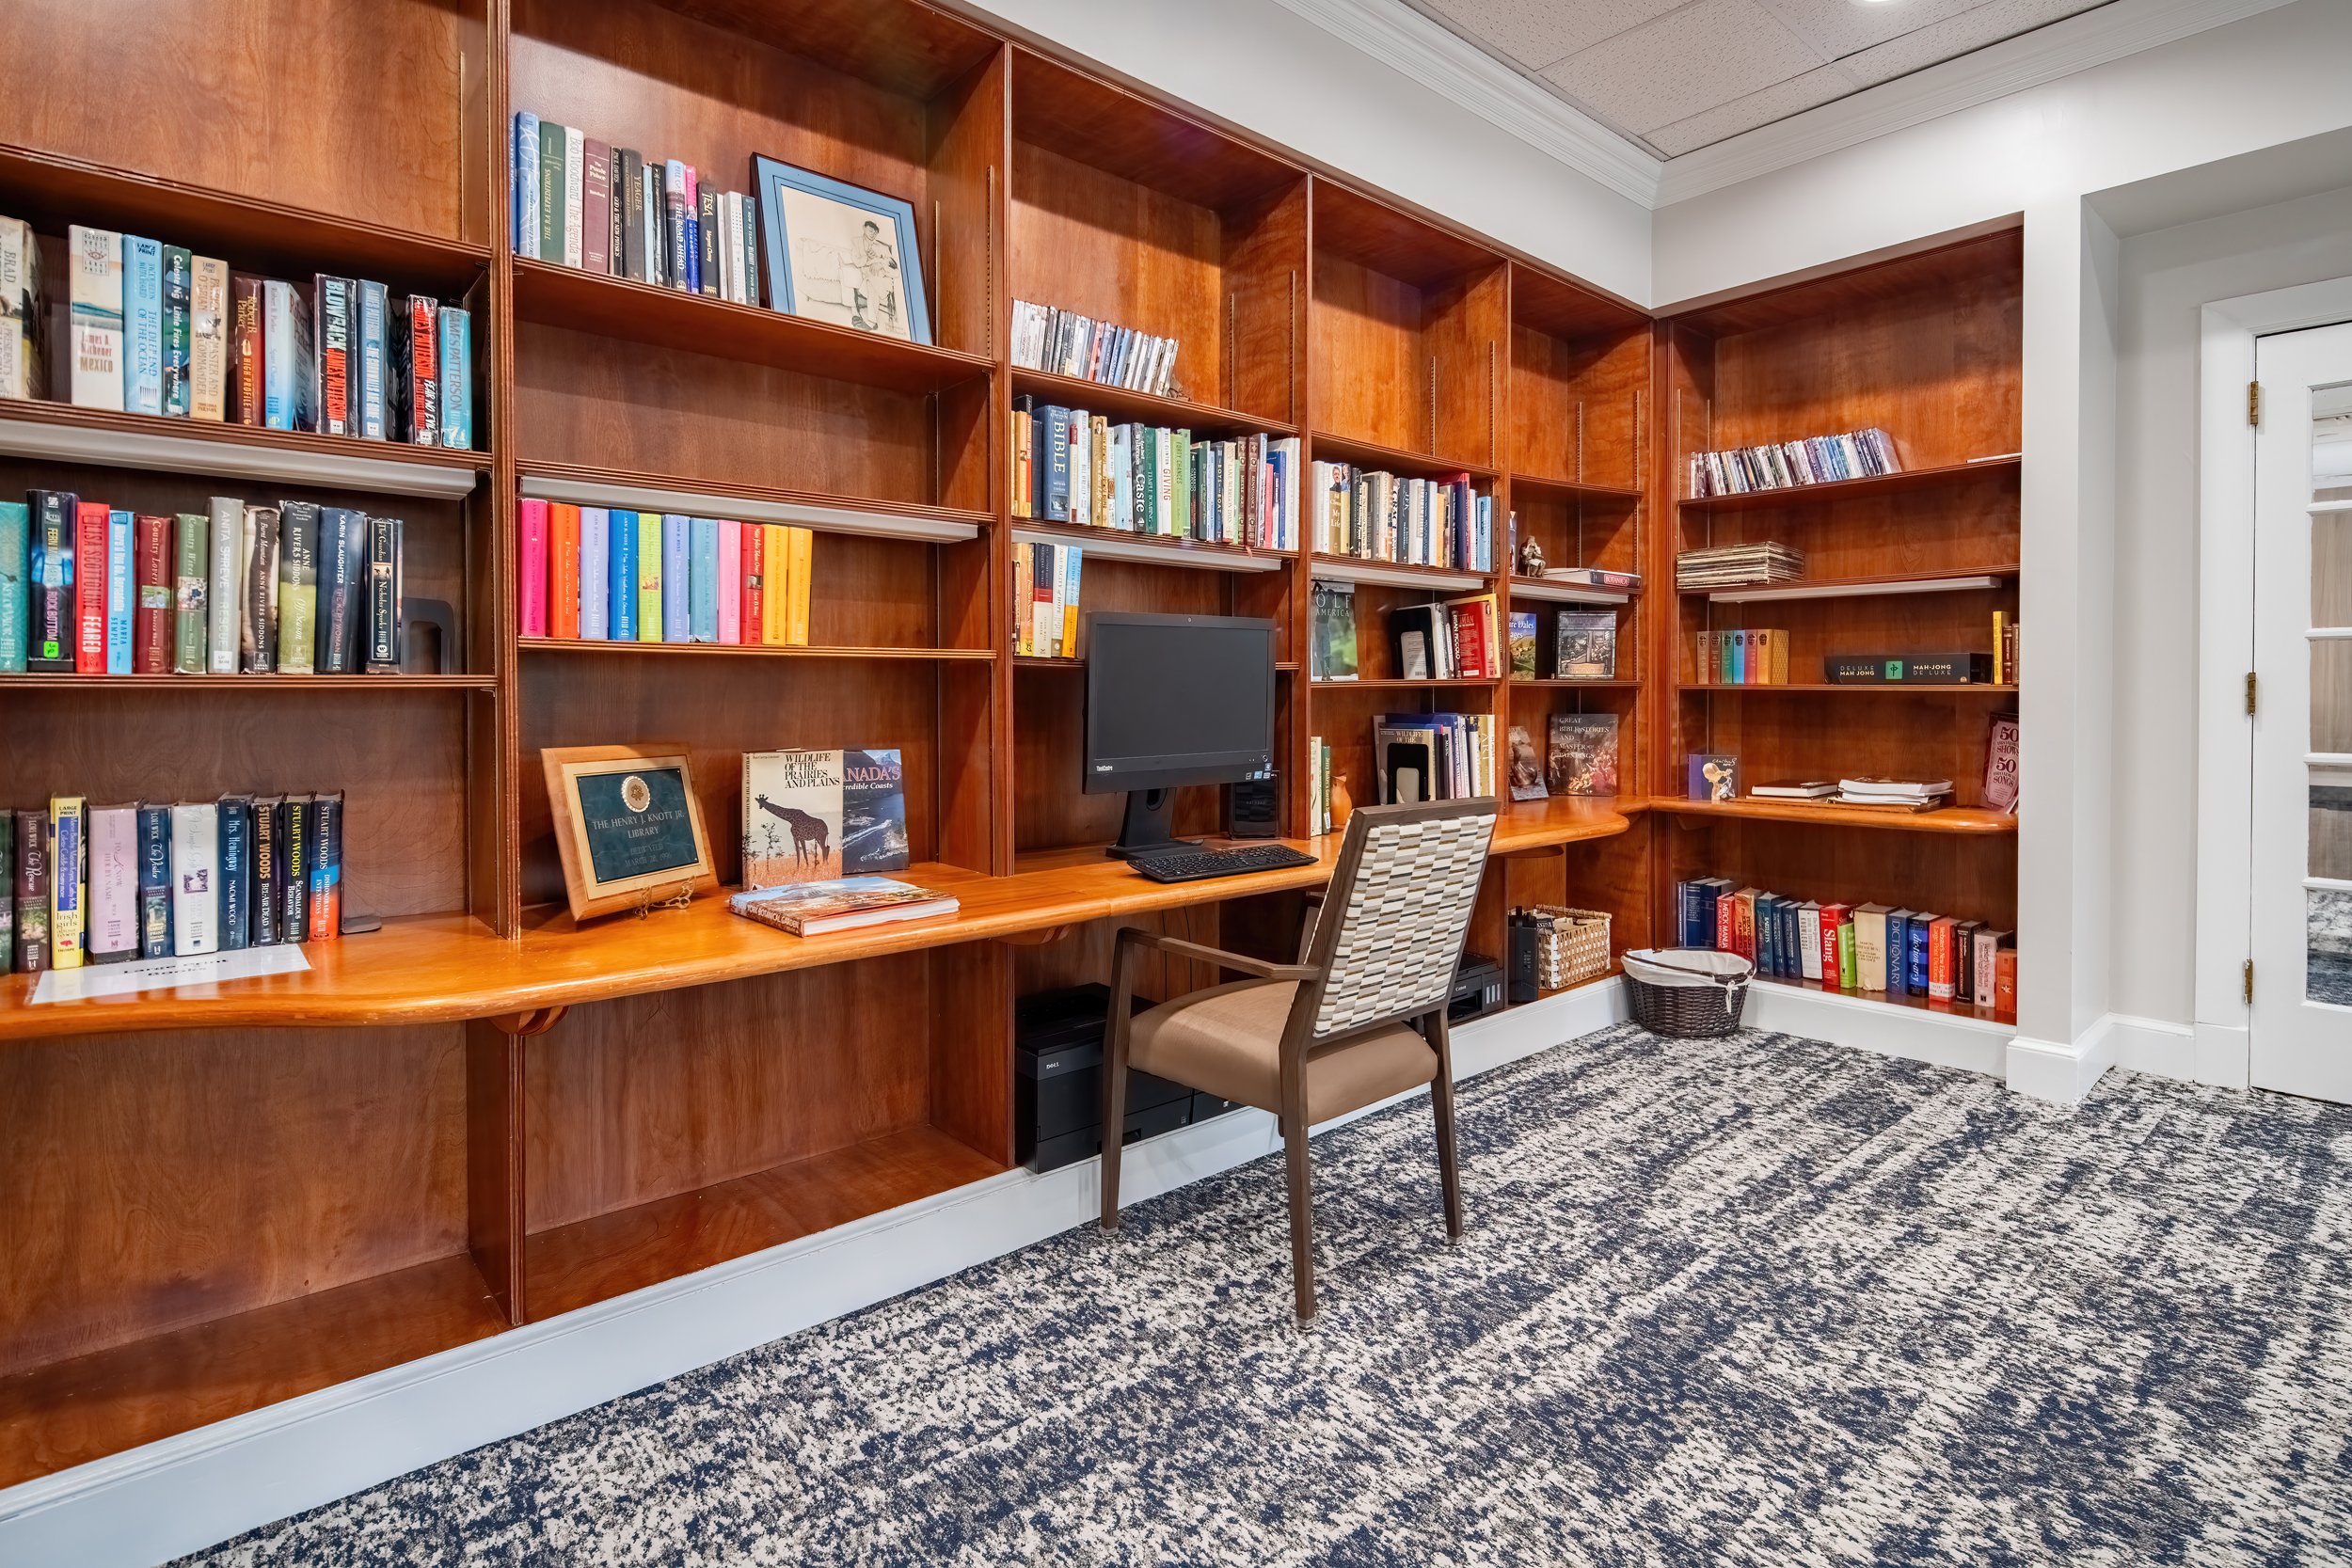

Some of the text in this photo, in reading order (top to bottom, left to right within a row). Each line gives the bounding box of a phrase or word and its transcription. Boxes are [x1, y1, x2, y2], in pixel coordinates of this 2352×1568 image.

[566, 137, 581, 254] Bob Woodward The Agenda
[702, 193, 713, 216] TESLA
[675, 220, 684, 242] ROAD
[4, 250, 16, 283] BRAD
[173, 254, 183, 284] Celeste
[171, 286, 183, 299] Ng
[237, 300, 246, 328] Parker
[246, 295, 257, 325] Robert
[173, 328, 182, 348] Fires
[326, 279, 346, 421] BLOWBACK JAMES PATTERSON
[138, 342, 147, 374] OCEAN
[414, 331, 435, 378] PATTERSON
[172, 350, 182, 399] Everywhere
[243, 357, 251, 406] HIGH PROFILE
[449, 346, 462, 411] PATTERSON
[424, 379, 435, 430] FEAR NO EVIL
[1054, 421, 1065, 473] BIBLE
[1136, 473, 1145, 512] Caste
[1163, 468, 1171, 500] GIVING
[1330, 519, 1341, 529] Life
[151, 521, 161, 585] Country Lovers
[186, 517, 197, 576] Country Wives
[219, 511, 230, 588] ANITA SHREVE
[292, 527, 301, 591] RIVERS SIDDONS
[302, 547, 310, 571] ANNE
[84, 525, 103, 610] LISA SCOTTOLINE
[1605, 576, 1629, 585] BOTANICA
[47, 591, 57, 641] ROCK BOTTOM
[376, 580, 388, 629] Nicholas Sparks
[1316, 609, 1349, 617] AMERICA
[82, 615, 102, 653] FEARED
[218, 601, 229, 646] RESCUE
[1518, 621, 1534, 629] Dales
[2000, 726, 2019, 743] 50
[785, 761, 818, 771] OF THE
[786, 752, 831, 763] WILDLIFE
[1995, 757, 2017, 773] 50
[785, 769, 828, 780] PRAIRIES
[785, 777, 840, 788] AND PLAINS
[1994, 776, 2013, 786] SONGS
[591, 810, 685, 831] THE HENRY J. KNOTT JR.
[628, 826, 660, 839] LIBRARY
[28, 833, 38, 847] WICK
[151, 844, 163, 856] The
[226, 820, 240, 872] Mrs. Hemingway
[259, 806, 271, 879] STUART WOODS
[292, 805, 301, 877] STUART WOODS
[319, 806, 329, 870] STUART WOODS
[25, 851, 41, 892] The Rescue
[56, 911, 78, 921] Irish
[1823, 928, 1836, 963] Slang
[1891, 921, 1900, 987] DICTIONARY
[1046, 1061, 1059, 1069] DELL
